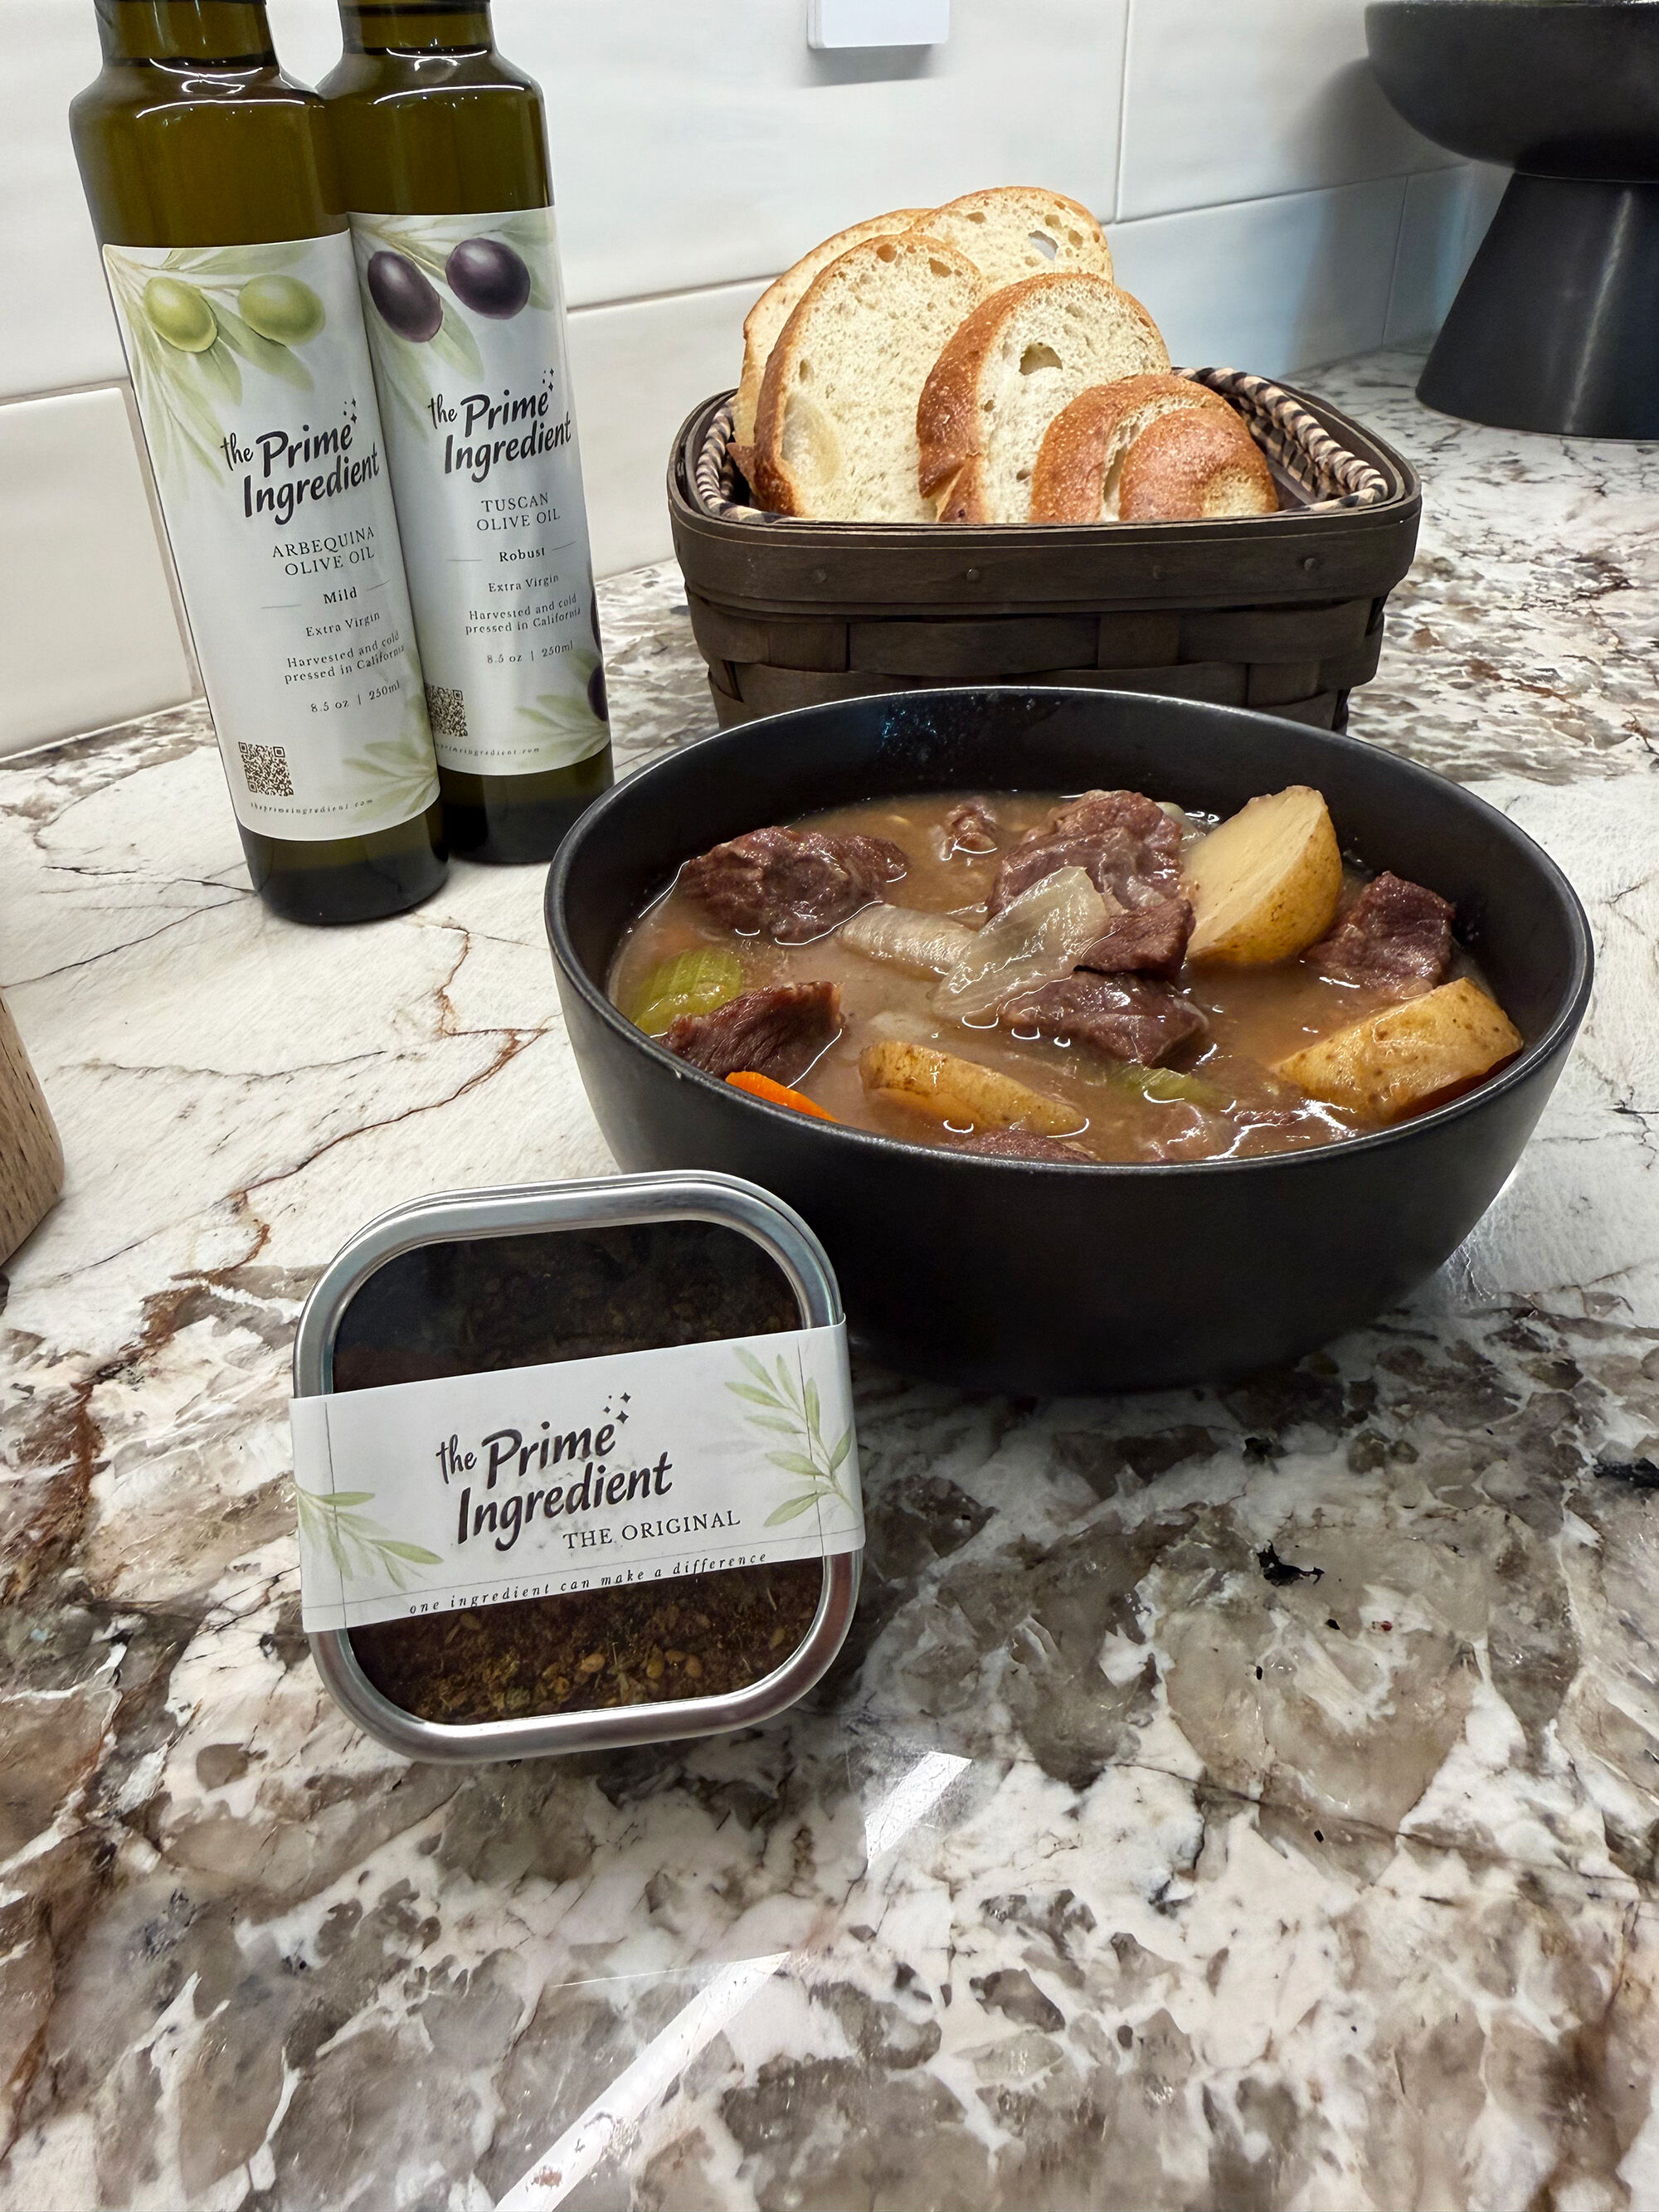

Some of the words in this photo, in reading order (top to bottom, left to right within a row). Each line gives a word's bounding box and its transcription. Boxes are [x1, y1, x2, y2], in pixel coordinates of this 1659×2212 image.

[427, 393, 458, 430] the
[460, 389, 549, 438] Prime
[220, 432, 254, 472] the
[255, 424, 353, 478] Prime
[445, 411, 572, 484] Ingredient
[244, 442, 380, 526] Ingredient
[481, 492, 549, 513] TUSCAN
[476, 514, 531, 531] OLIVE
[536, 508, 561, 524] OIL
[272, 526, 375, 558] ARBEQUINA
[499, 547, 546, 562] Robust
[285, 555, 343, 576] OLIVE
[349, 546, 375, 564] OIL
[323, 586, 358, 605] Mild
[488, 582, 522, 593] Extra
[525, 574, 559, 587] Virgin
[469, 605, 532, 620] Harvested
[536, 600, 555, 614] and
[558, 592, 577, 608] cold
[305, 623, 342, 638] Extra
[345, 611, 381, 629] Virgin
[465, 622, 513, 635] pressed
[517, 621, 528, 631] in
[533, 607, 581, 628] California
[286, 648, 354, 668] Harvested
[358, 641, 378, 656] and
[382, 630, 400, 647] cold
[487, 654, 504, 664] 8.5
[508, 654, 523, 663] oz
[284, 666, 335, 685] pressed
[339, 664, 353, 675] in
[310, 701, 330, 713] 8.5
[335, 699, 349, 709] oz
[435, 1433, 478, 1485] the
[481, 1421, 616, 1490] Prime
[457, 1451, 674, 1552] Ingredient
[562, 1528, 613, 1549] THE
[621, 1510, 742, 1542] ORIGINAL
[409, 1600, 440, 1615] one
[450, 1582, 550, 1607] ingredient
[560, 1578, 590, 1592] can
[601, 1569, 645, 1587] make
[654, 1568, 662, 1578] a
[673, 1552, 766, 1575] difference
